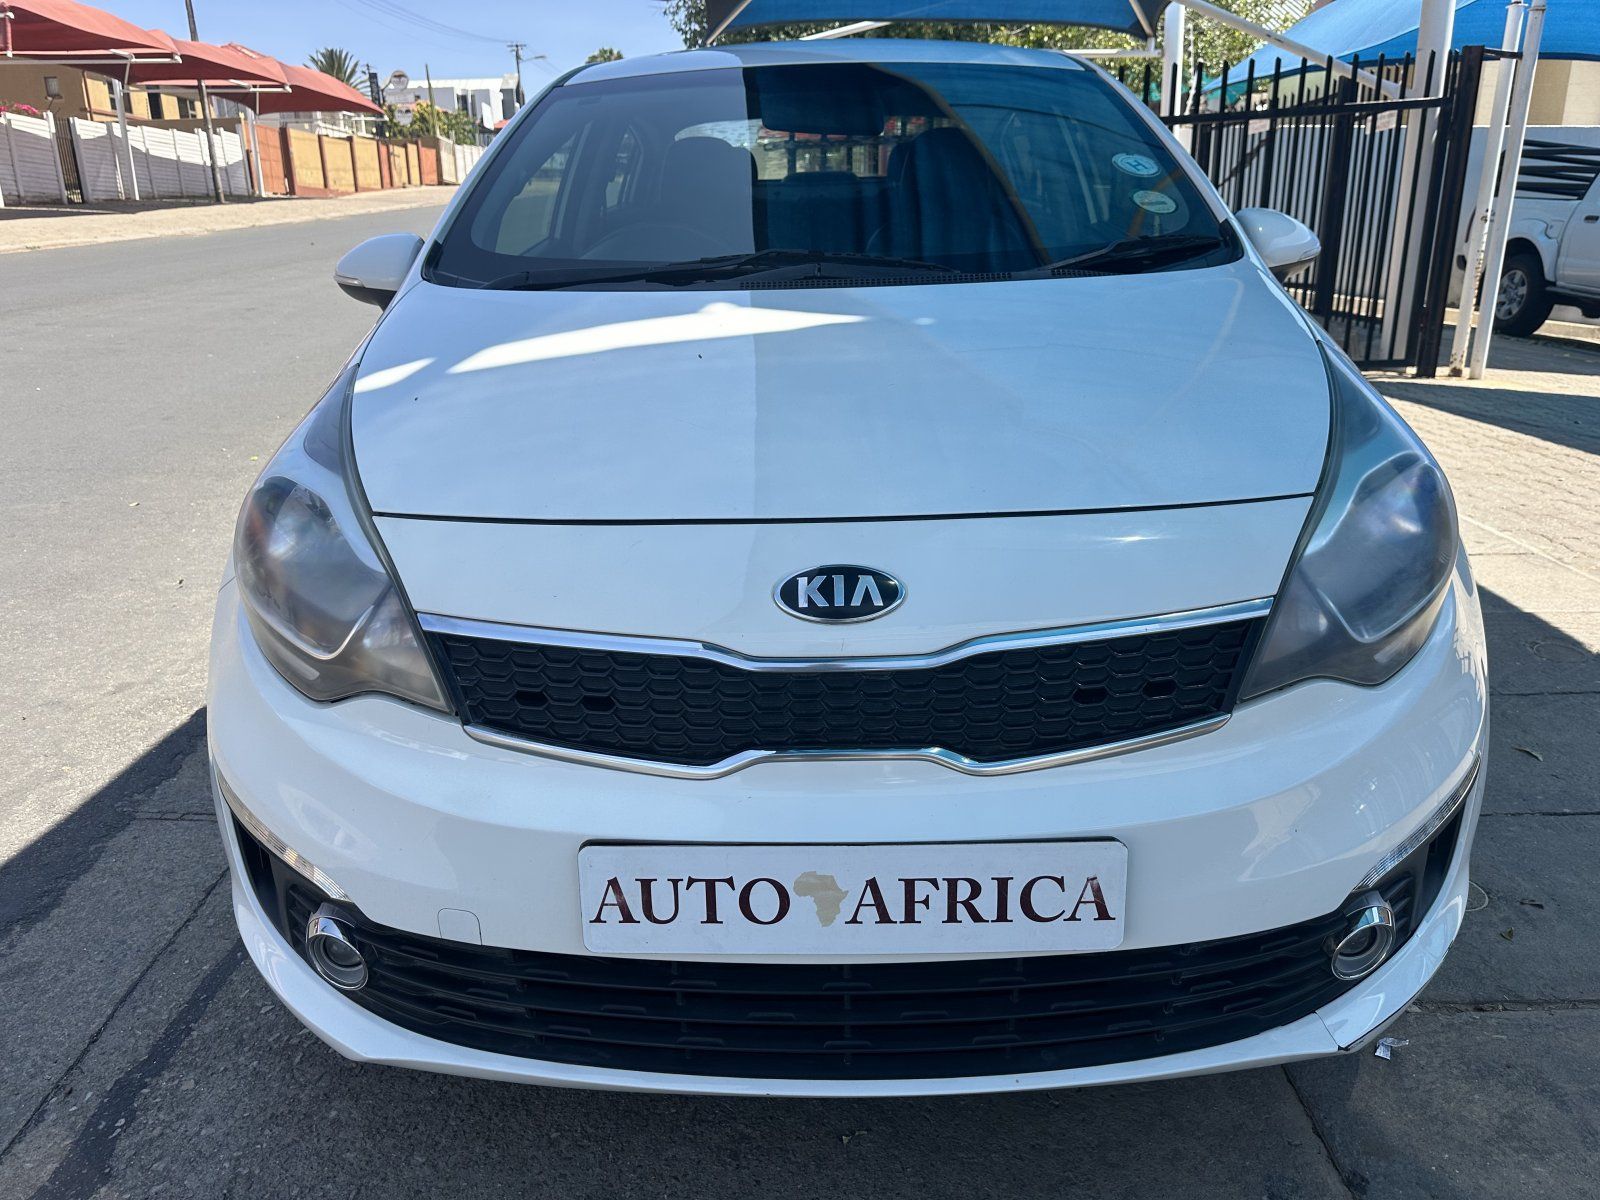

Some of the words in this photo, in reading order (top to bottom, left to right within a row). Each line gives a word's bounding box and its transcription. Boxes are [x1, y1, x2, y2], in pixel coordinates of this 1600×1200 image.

[796, 574, 884, 608] KIA
[589, 876, 791, 925] AUTO
[845, 875, 1116, 925] AFRICA
